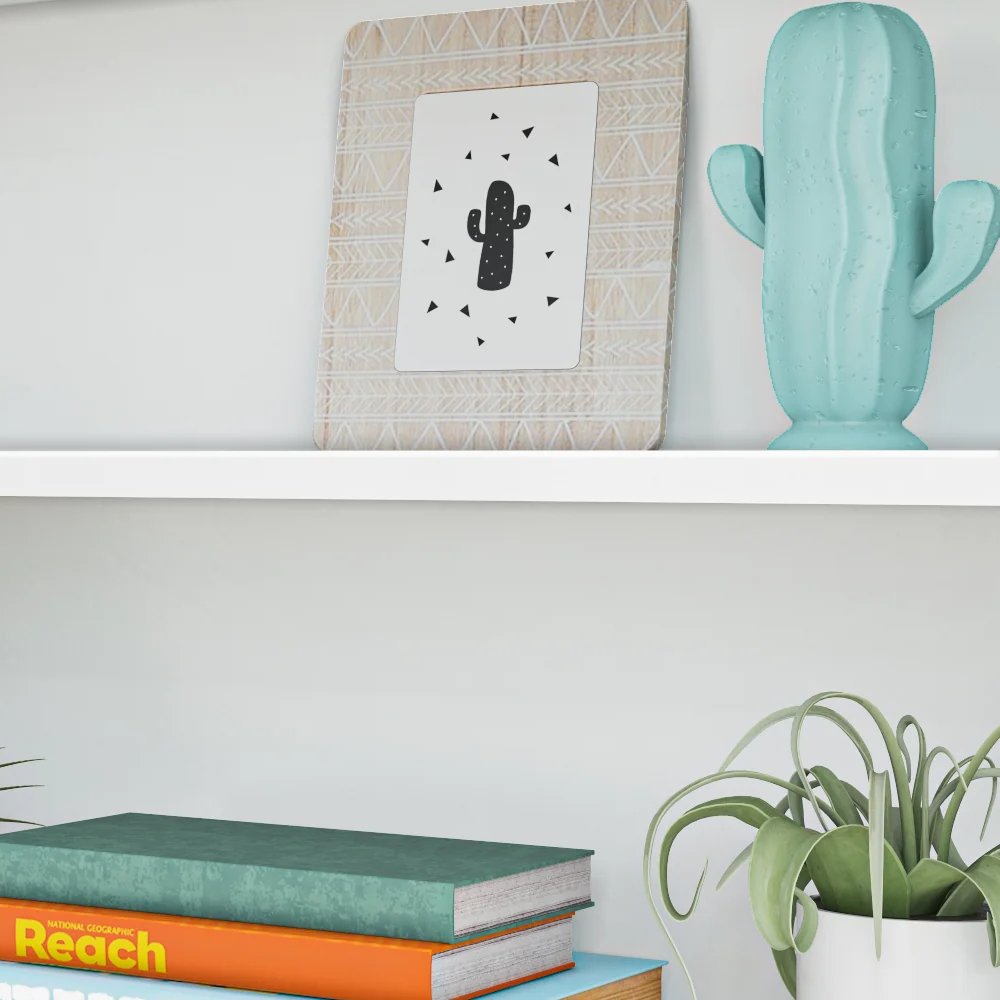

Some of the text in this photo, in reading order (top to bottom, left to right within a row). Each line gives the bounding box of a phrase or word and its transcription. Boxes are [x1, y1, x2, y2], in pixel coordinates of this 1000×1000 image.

[15, 918, 167, 973] Reach
[47, 920, 135, 937] NATIONAL GEOGRAPHIC
